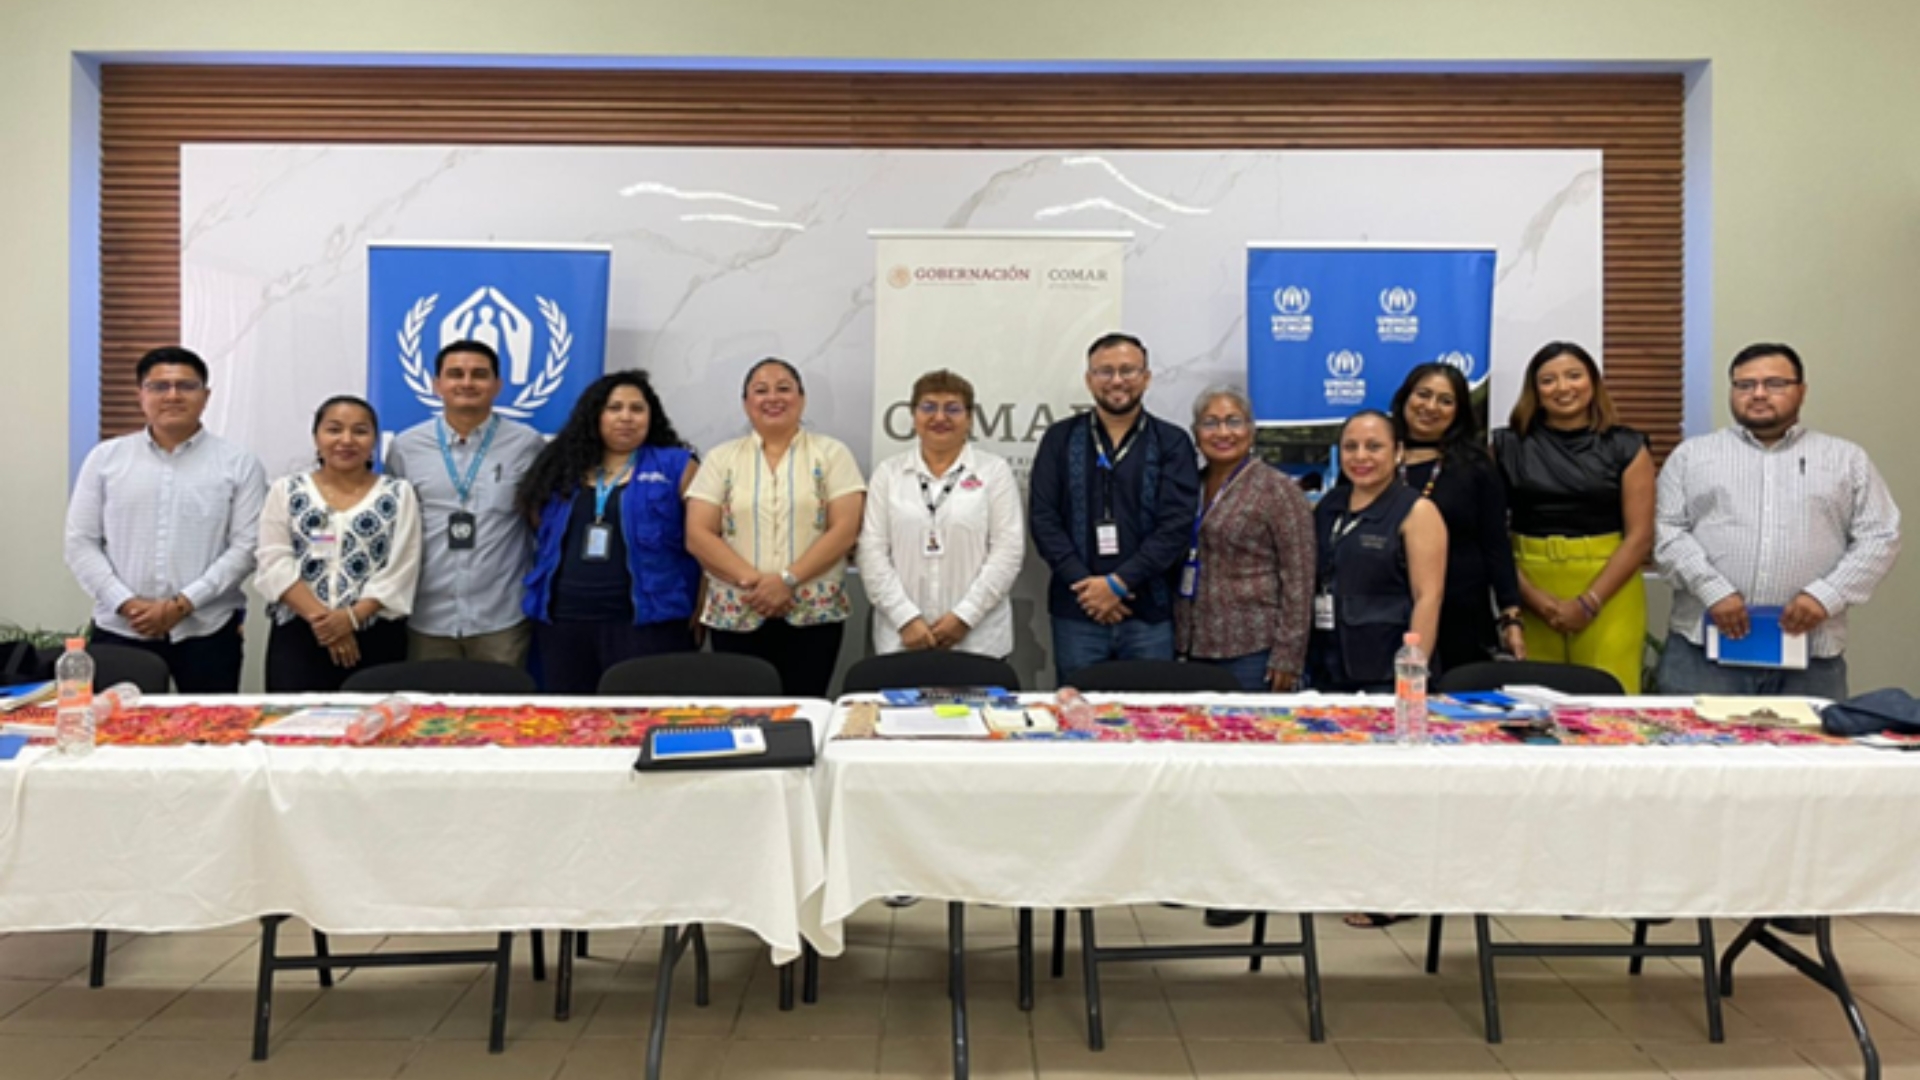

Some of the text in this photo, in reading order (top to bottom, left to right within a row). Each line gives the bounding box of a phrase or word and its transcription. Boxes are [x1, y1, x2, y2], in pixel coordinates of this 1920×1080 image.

[914, 265, 1031, 281] GOBERNACIÓN
[1048, 269, 1108, 281] COMAR
[883, 401, 1094, 442] CMA
